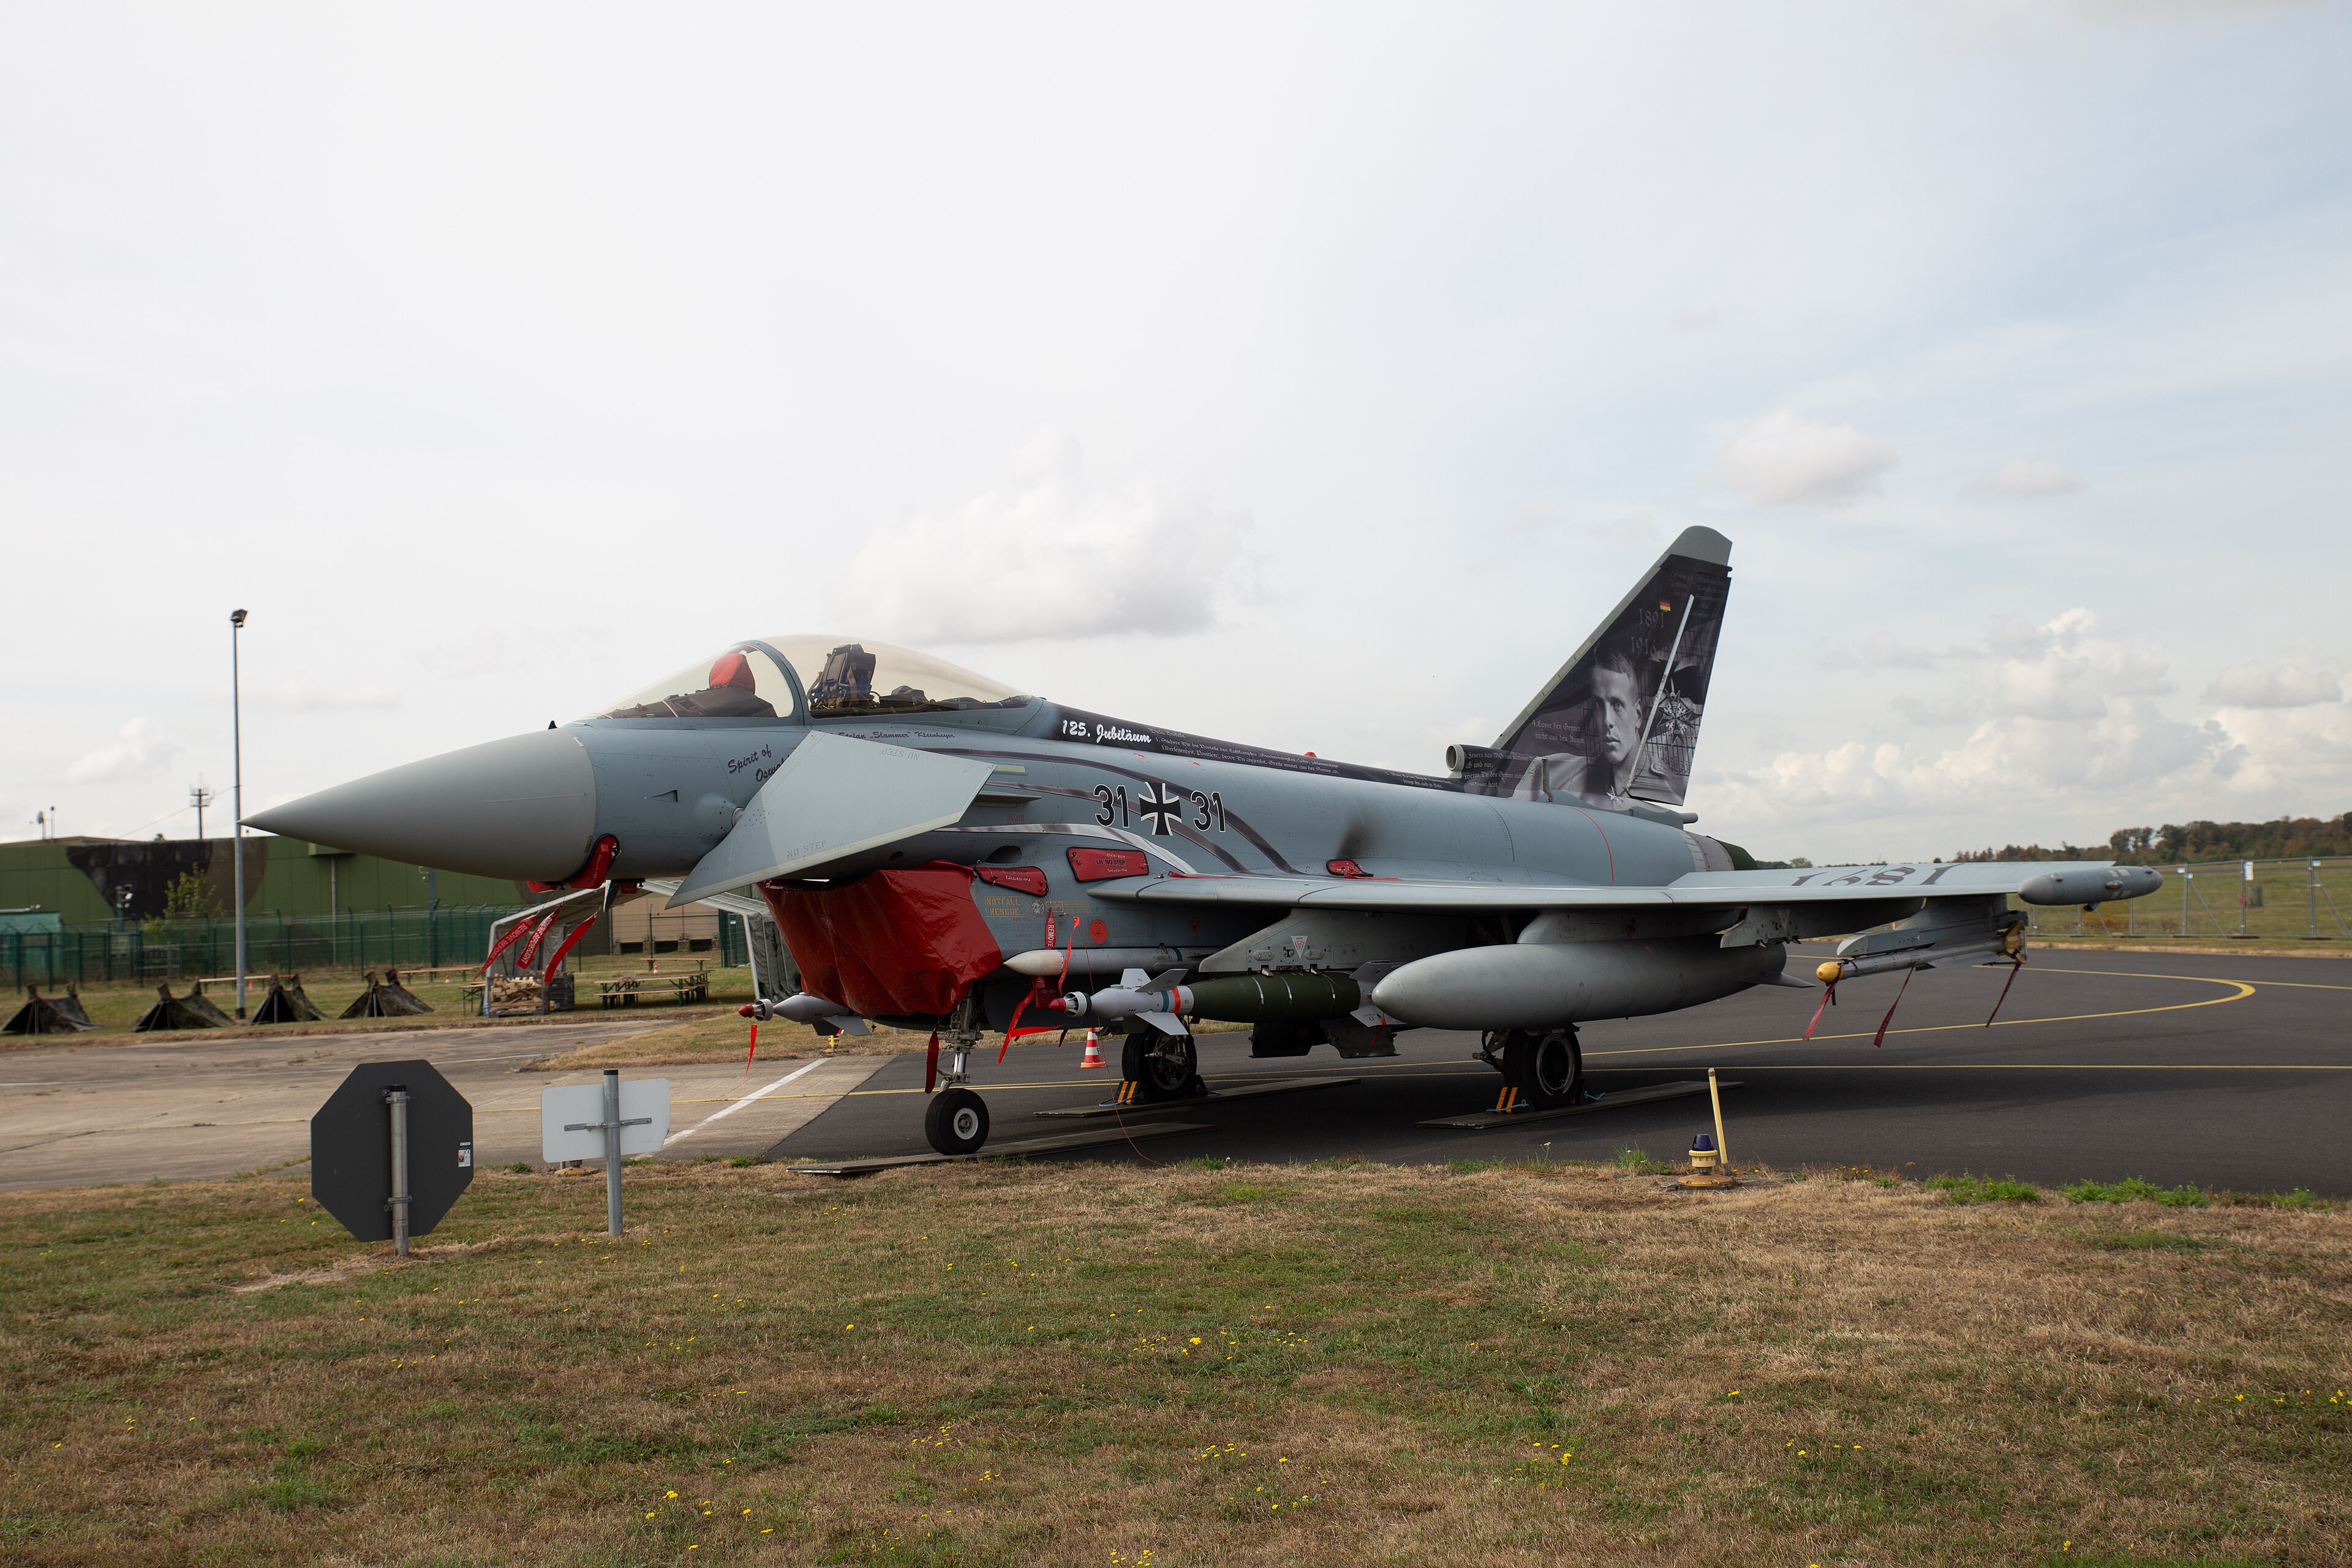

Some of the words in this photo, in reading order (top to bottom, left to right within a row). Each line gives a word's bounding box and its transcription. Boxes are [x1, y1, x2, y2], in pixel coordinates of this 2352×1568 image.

[1638, 608, 1665, 628] 1891
[1630, 636, 1657, 658] 1916
[914, 731, 956, 739] Kleinheyer
[1062, 719, 1091, 737] 125.
[1096, 723, 1152, 744] Jubiläum
[1535, 732, 1548, 741] nicht
[1563, 723, 1581, 733] Gegner
[1161, 737, 1180, 745] Sichere
[727, 751, 759, 774] Spirit
[761, 743, 772, 758] of
[882, 747, 905, 758] STEP
[1093, 783, 1130, 829] 31
[1190, 790, 1226, 833] 31
[786, 848, 799, 858] NO
[803, 840, 827, 853] STEP
[986, 897, 1021, 907] NOTFALL
[989, 907, 1020, 916] RESCUE
[506, 923, 528, 942] REMOVE
[537, 917, 552, 936] REMOVE
[490, 937, 510, 960] BEFORE
